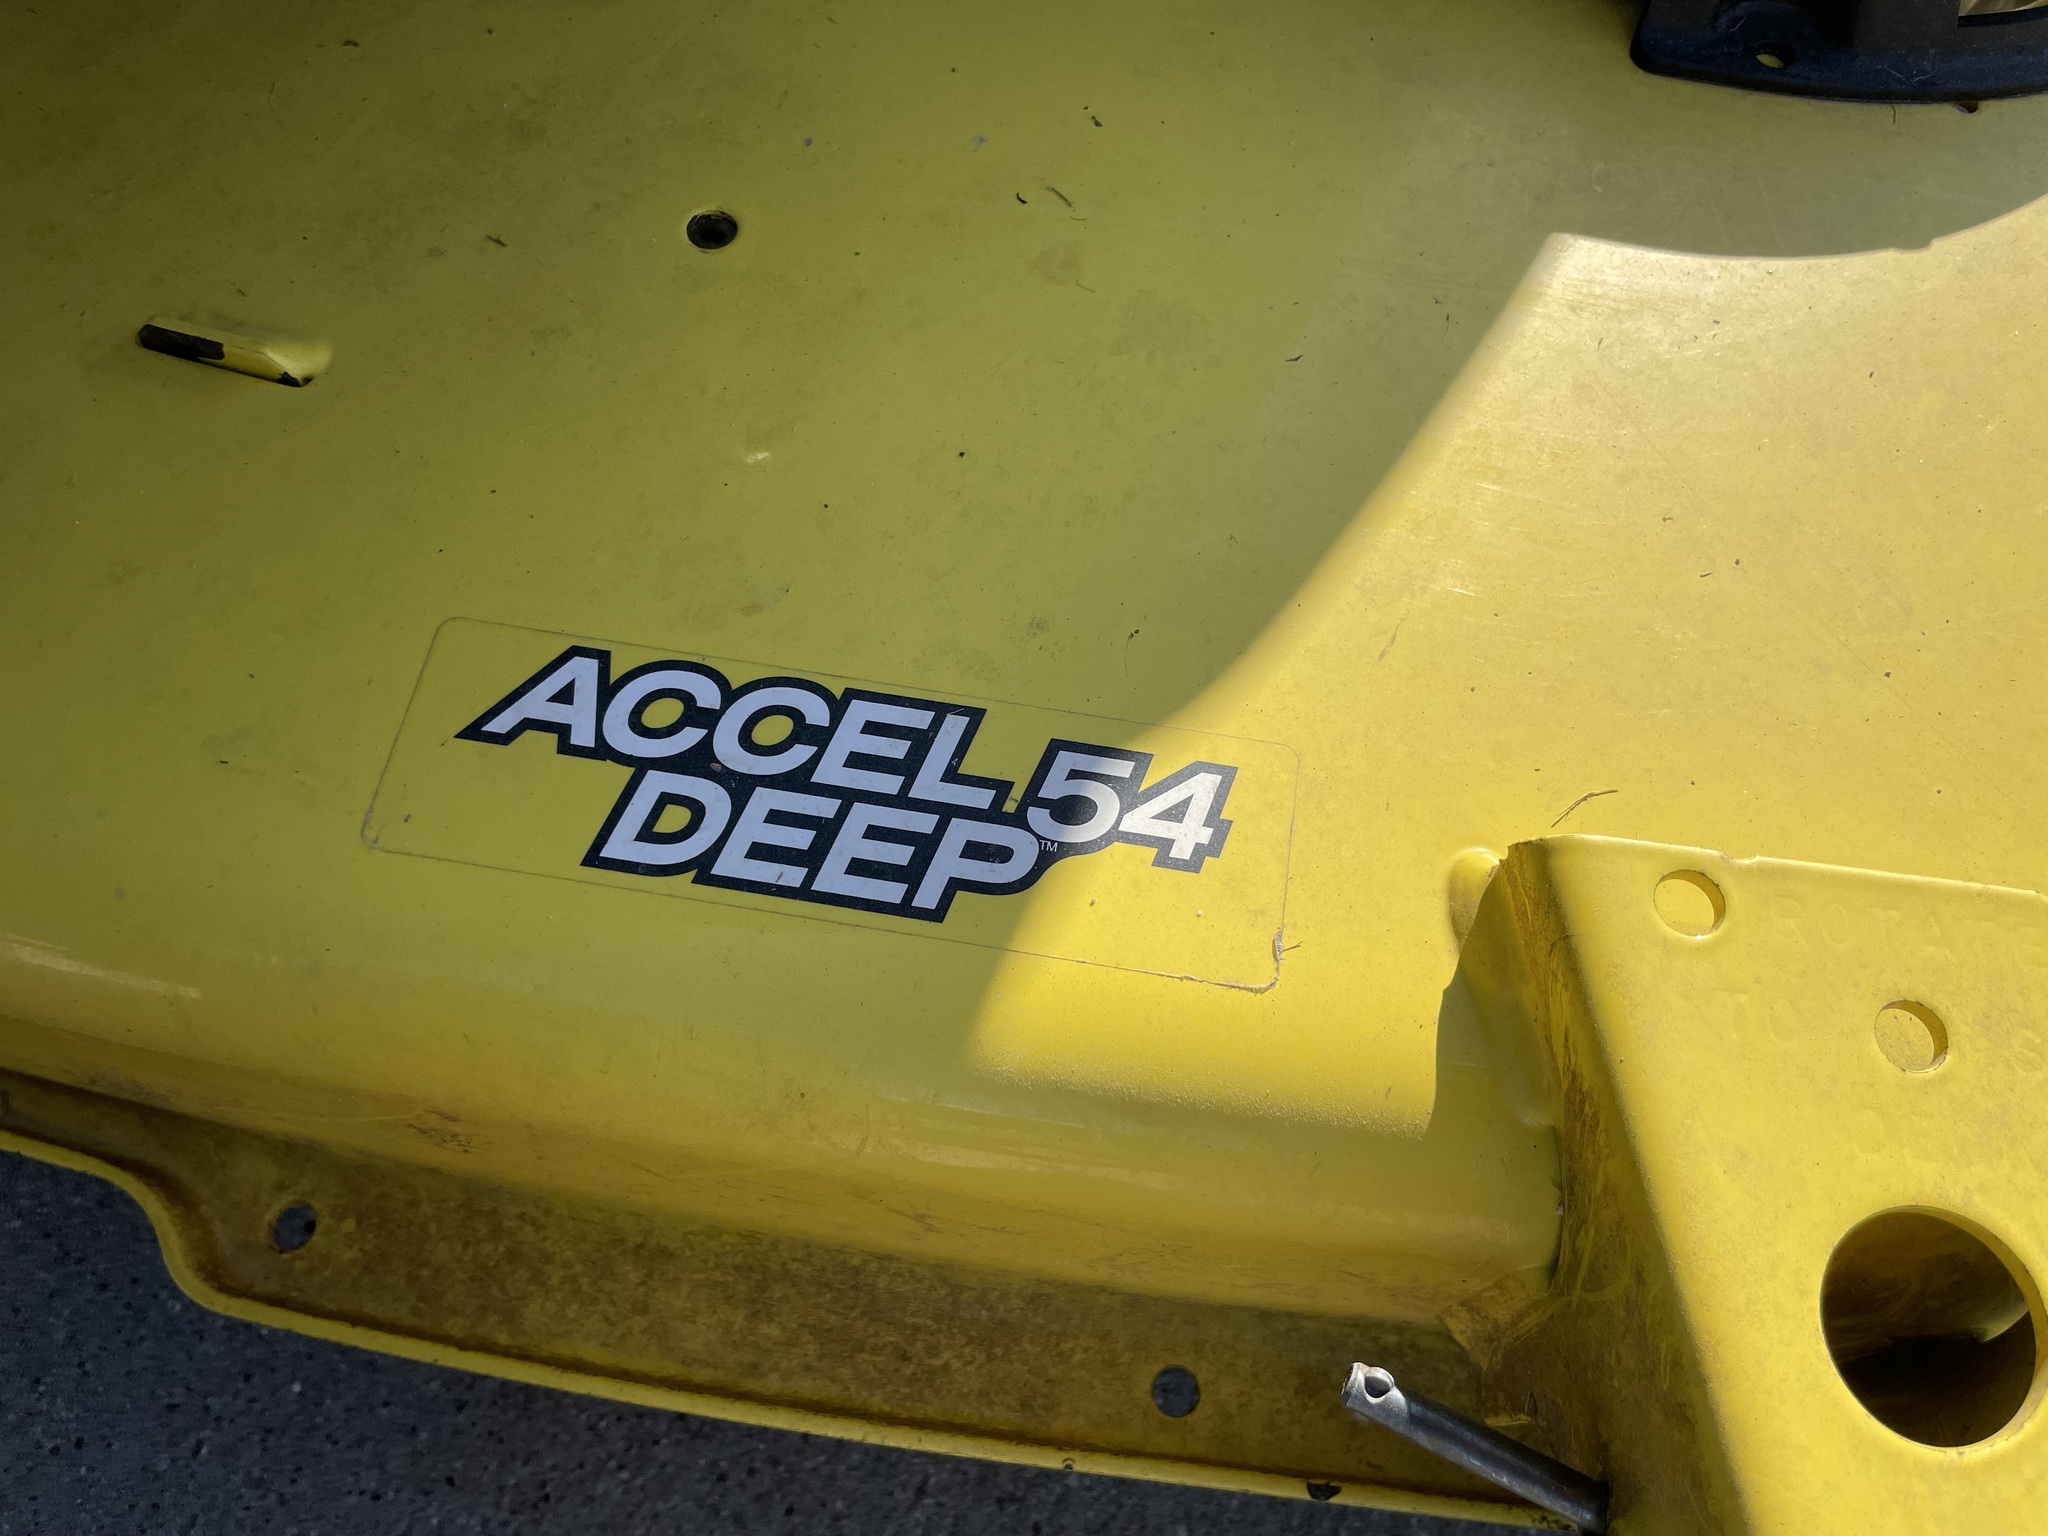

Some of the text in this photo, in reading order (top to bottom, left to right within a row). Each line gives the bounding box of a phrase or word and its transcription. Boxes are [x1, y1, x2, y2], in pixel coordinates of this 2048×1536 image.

[481, 655, 997, 810] ACCEL
[599, 769, 1040, 910] DEEP
[1026, 750, 1222, 860] 54
